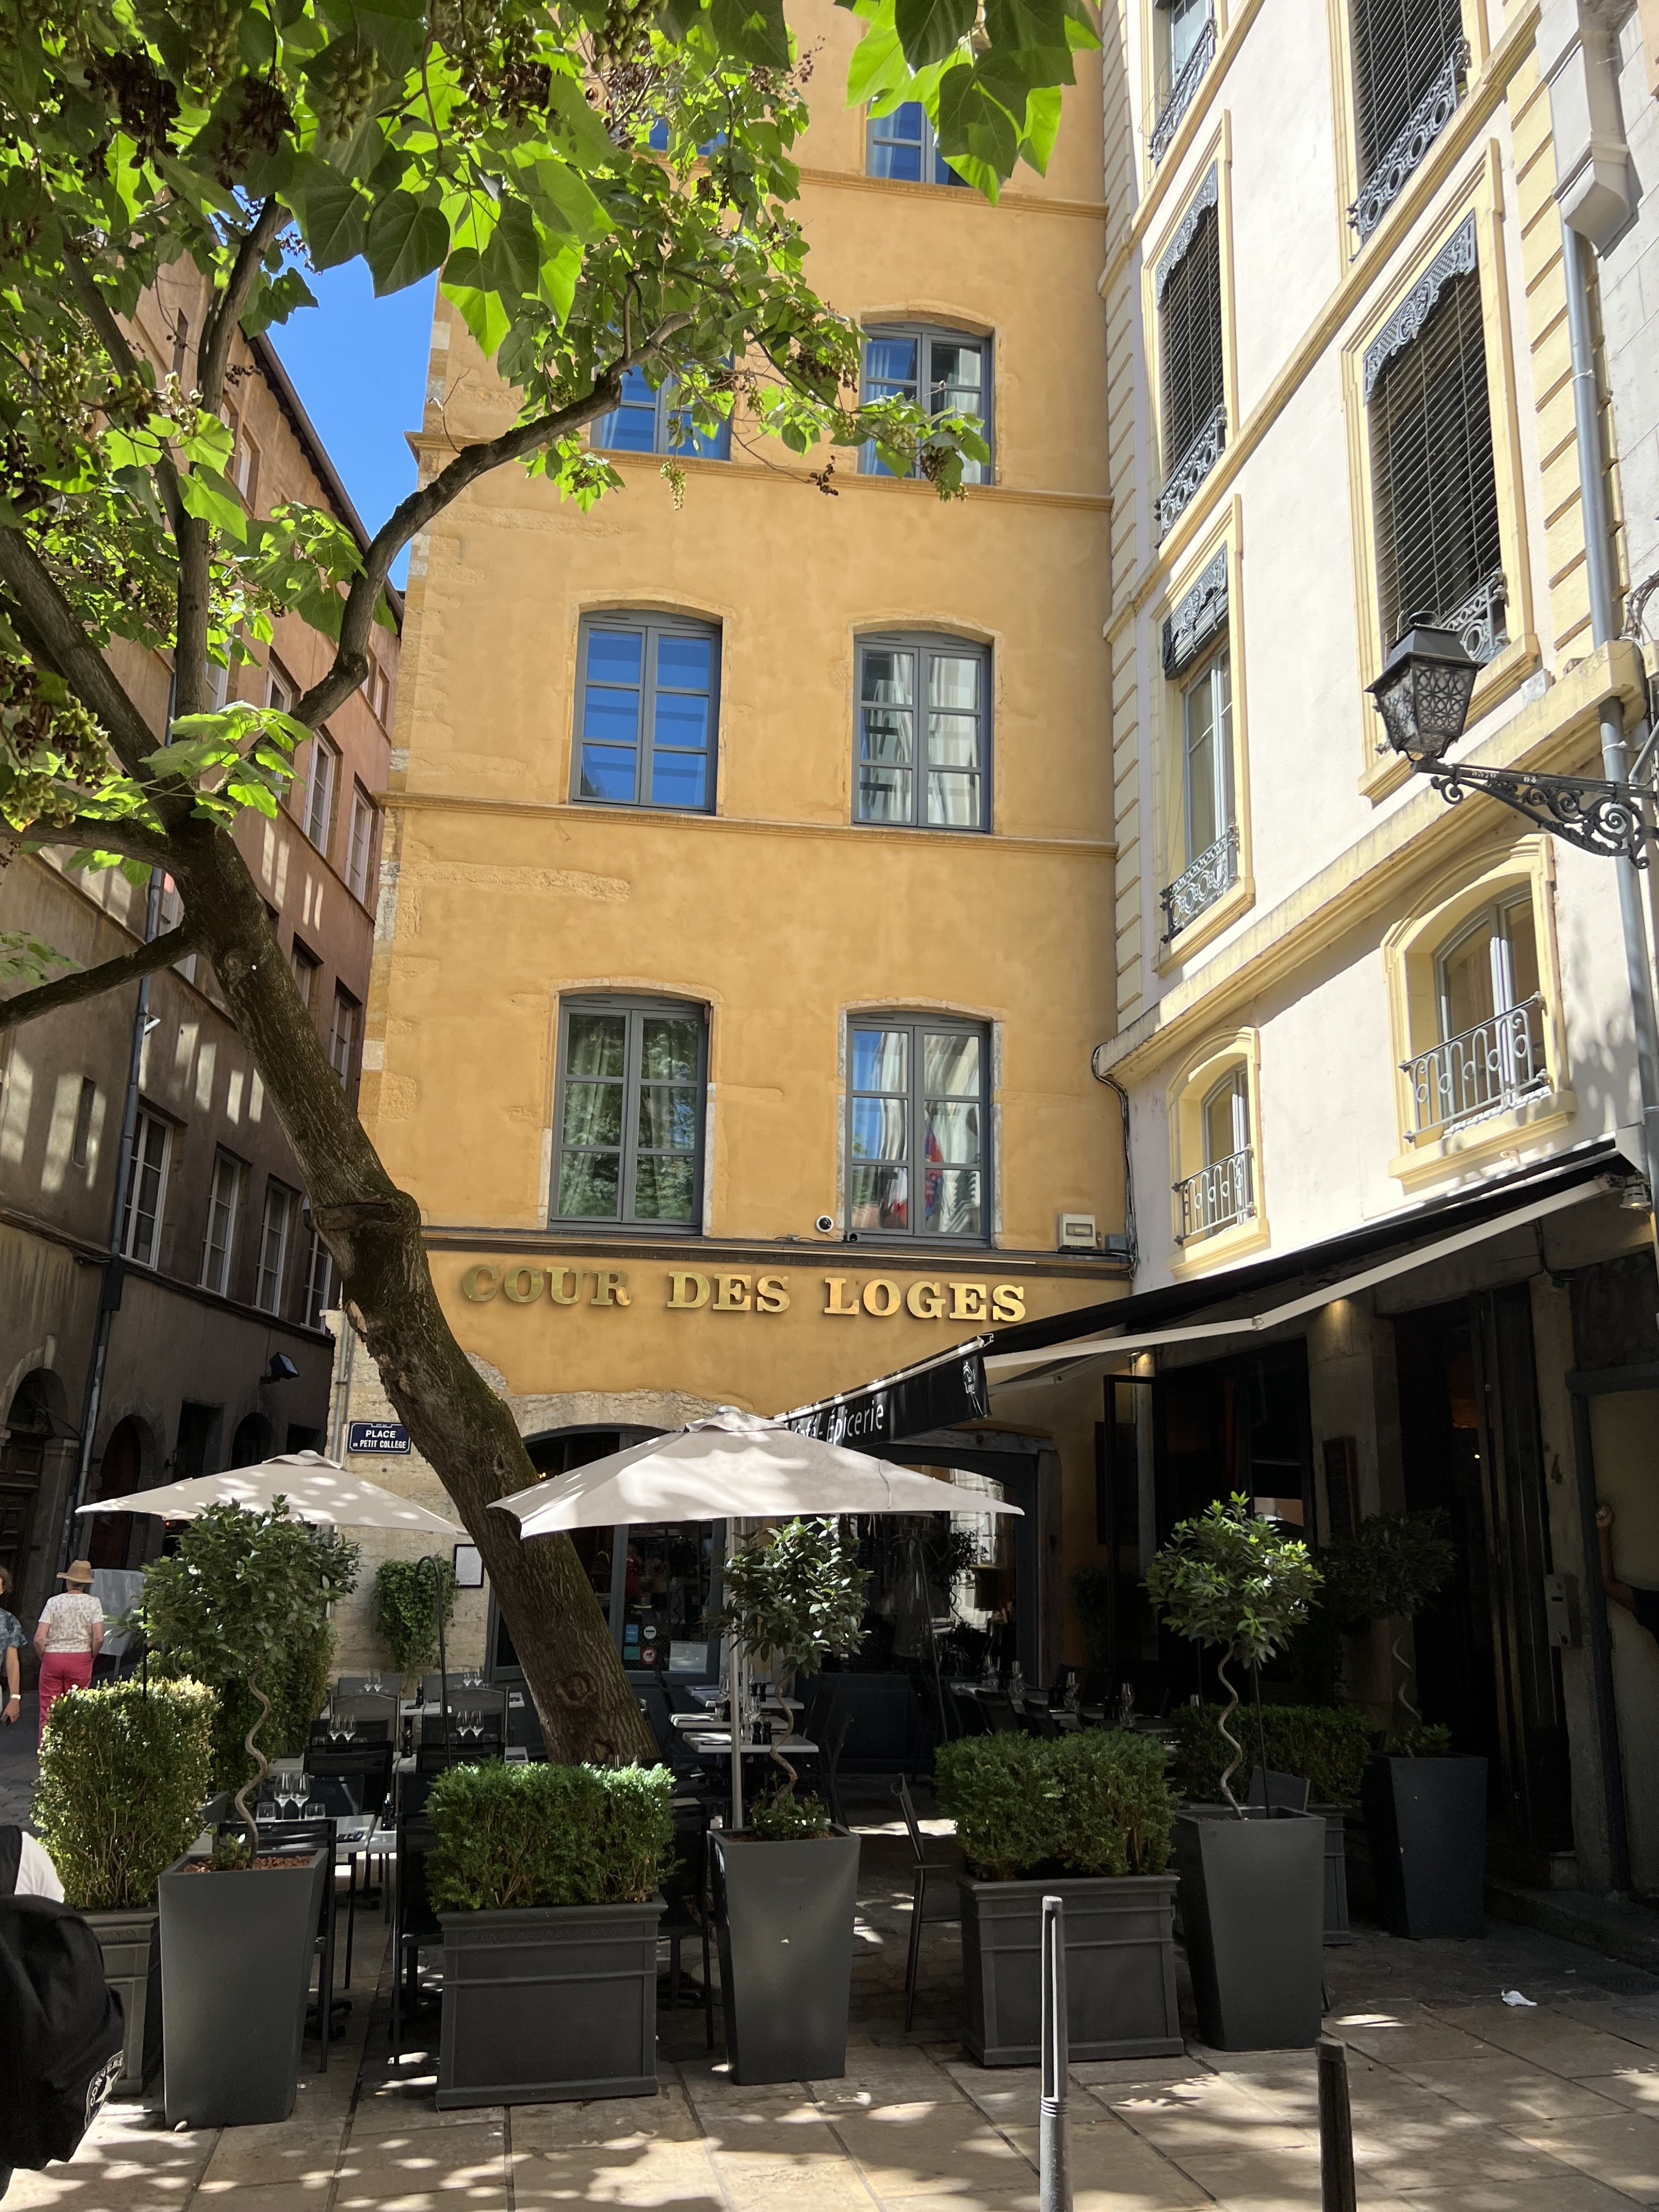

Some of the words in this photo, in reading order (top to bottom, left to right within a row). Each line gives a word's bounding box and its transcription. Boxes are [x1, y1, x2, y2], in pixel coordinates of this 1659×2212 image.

[462, 1263, 631, 1306] COUR
[667, 1271, 790, 1313] DES
[823, 1277, 1026, 1322] LOGES
[365, 1430, 396, 1438] PLACE
[359, 1439, 377, 1448] PETIT
[379, 1440, 407, 1449] COLLÈGE
